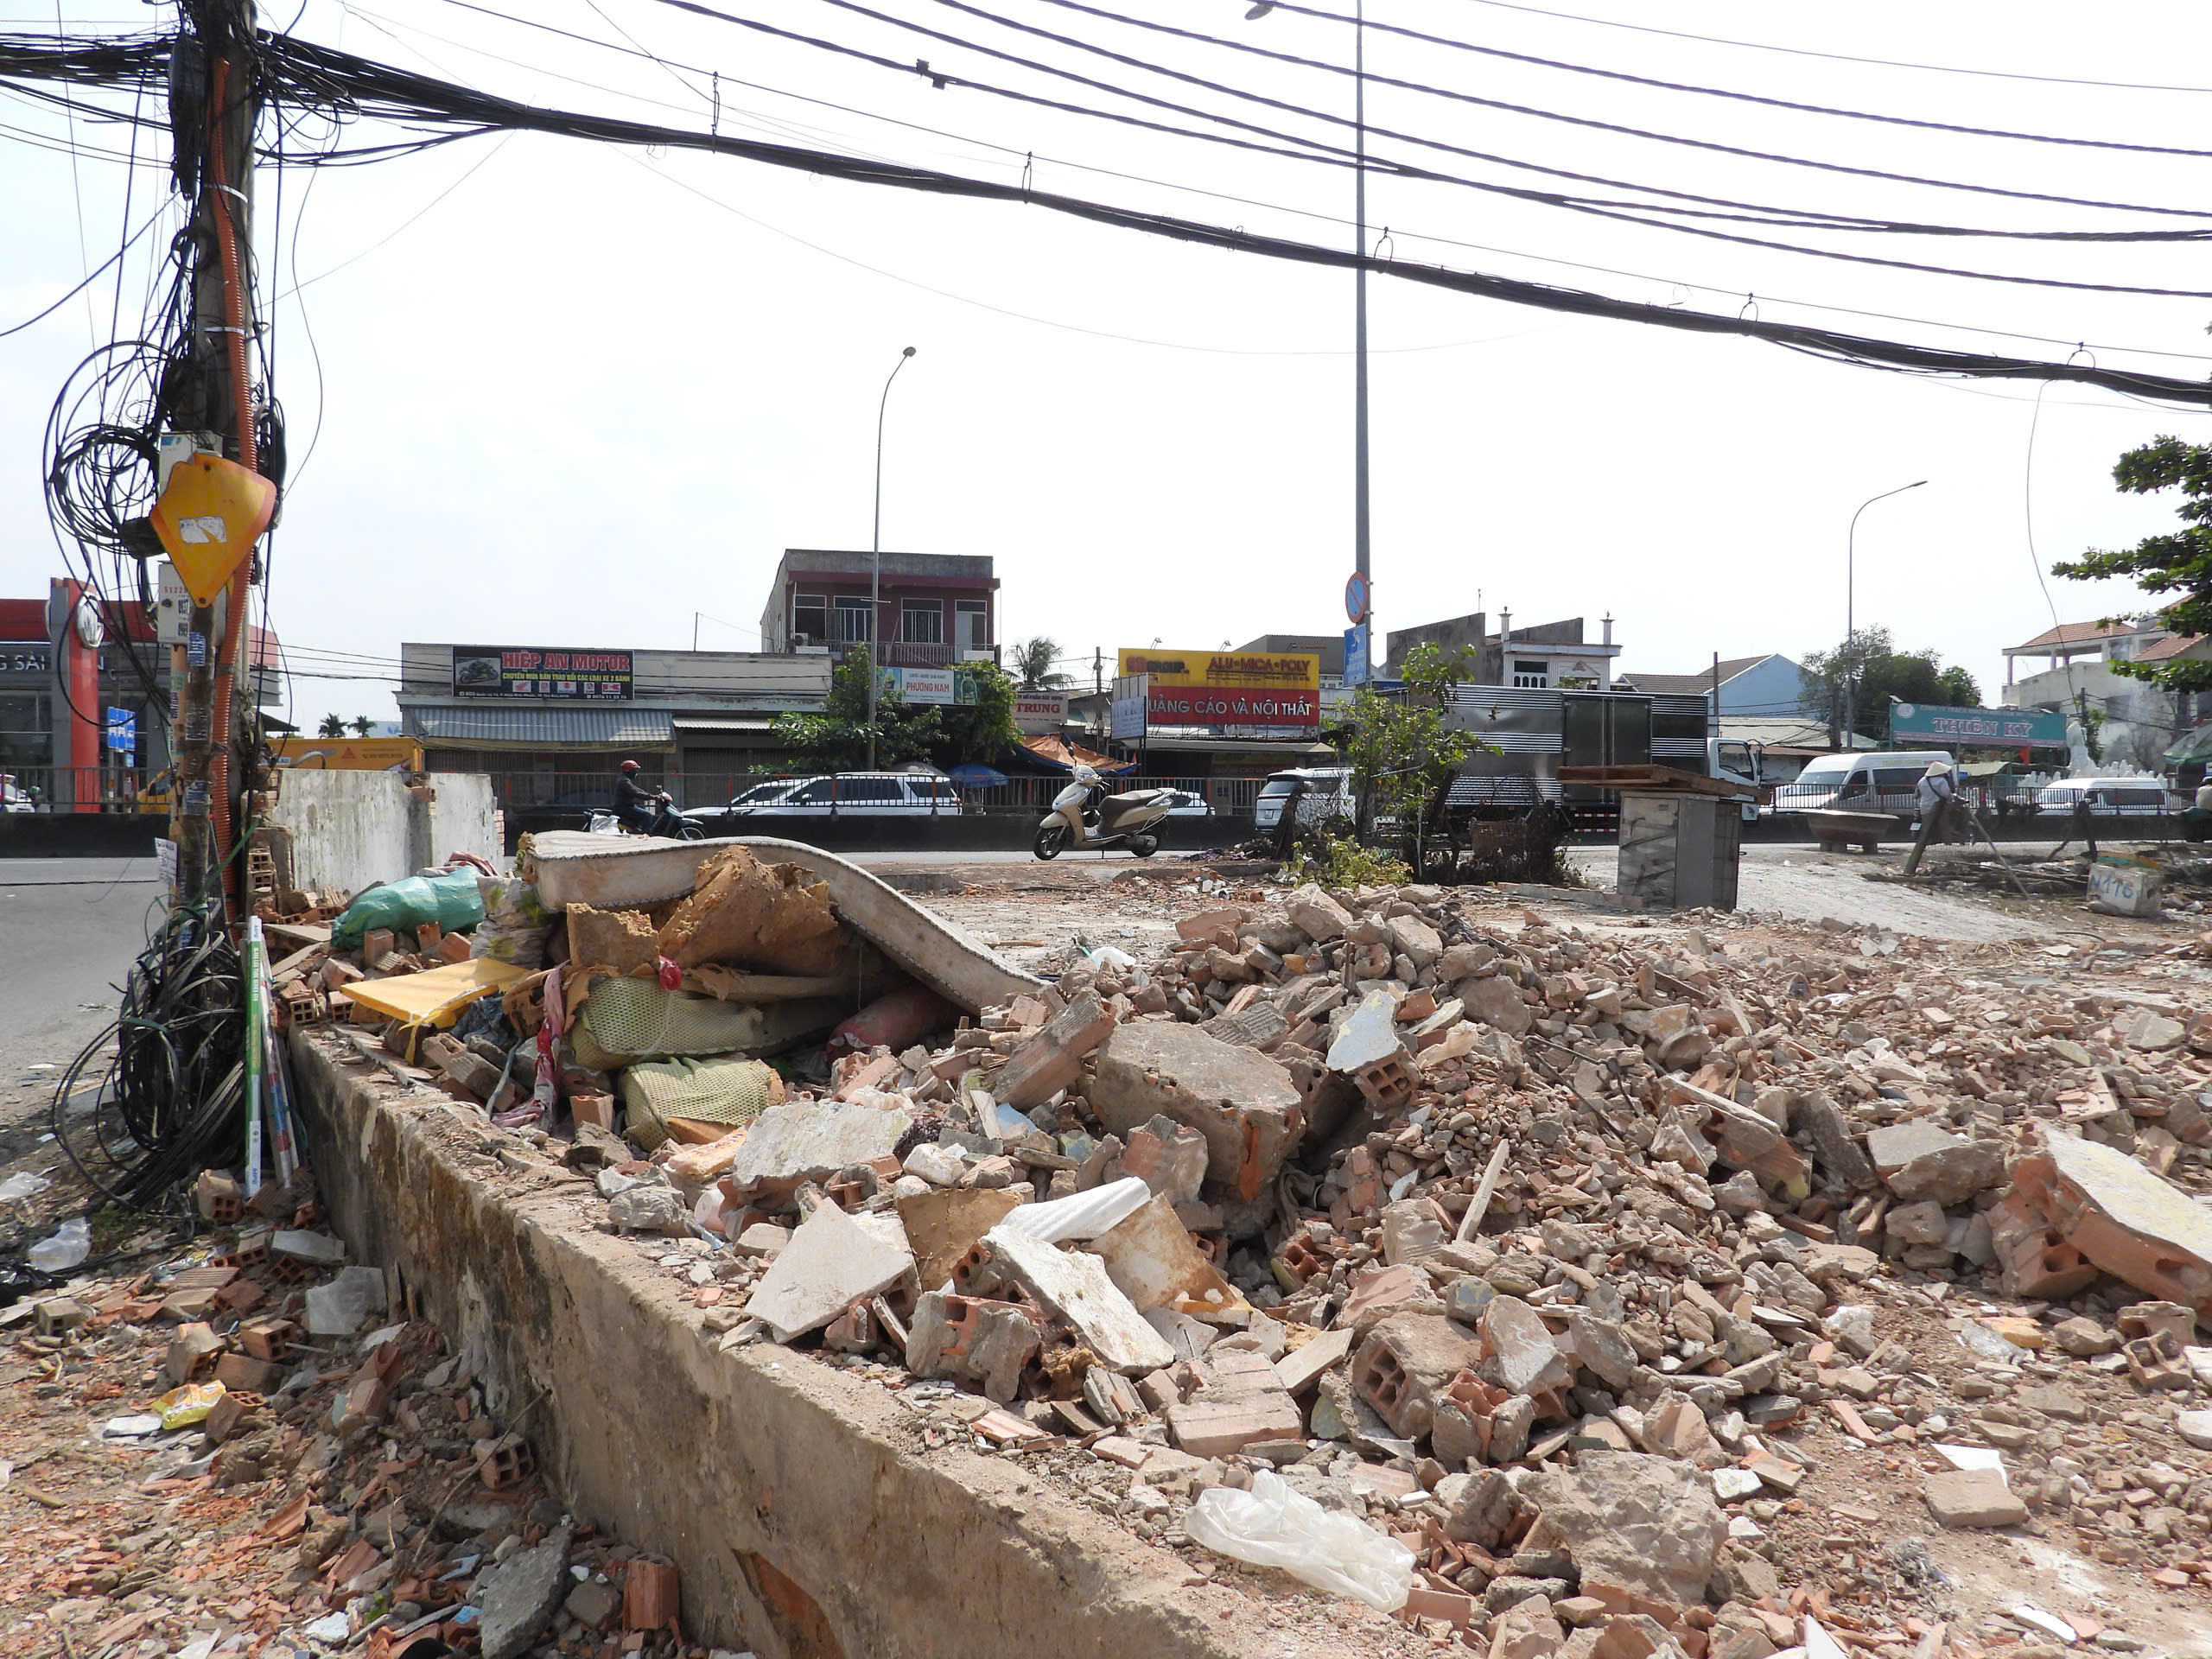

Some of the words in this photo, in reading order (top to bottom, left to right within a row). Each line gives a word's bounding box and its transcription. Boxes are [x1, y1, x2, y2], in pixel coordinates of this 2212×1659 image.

[502, 650, 541, 671] HIỆP
[543, 653, 569, 671] AN
[572, 654, 630, 671] MOTOR
[1209, 656, 1234, 670] ALU
[1241, 657, 1274, 671] MICA
[1281, 659, 1312, 672] POLY
[934, 683, 950, 692] NAM
[1016, 702, 1061, 714] TRUNG
[1147, 694, 1191, 714] UẢNG
[1194, 696, 1228, 715] CÁO
[1231, 697, 1249, 715] VÀ
[1253, 698, 1278, 719] NỘI
[1281, 696, 1311, 716] THẤT
[1932, 716, 1999, 736] THIÊN
